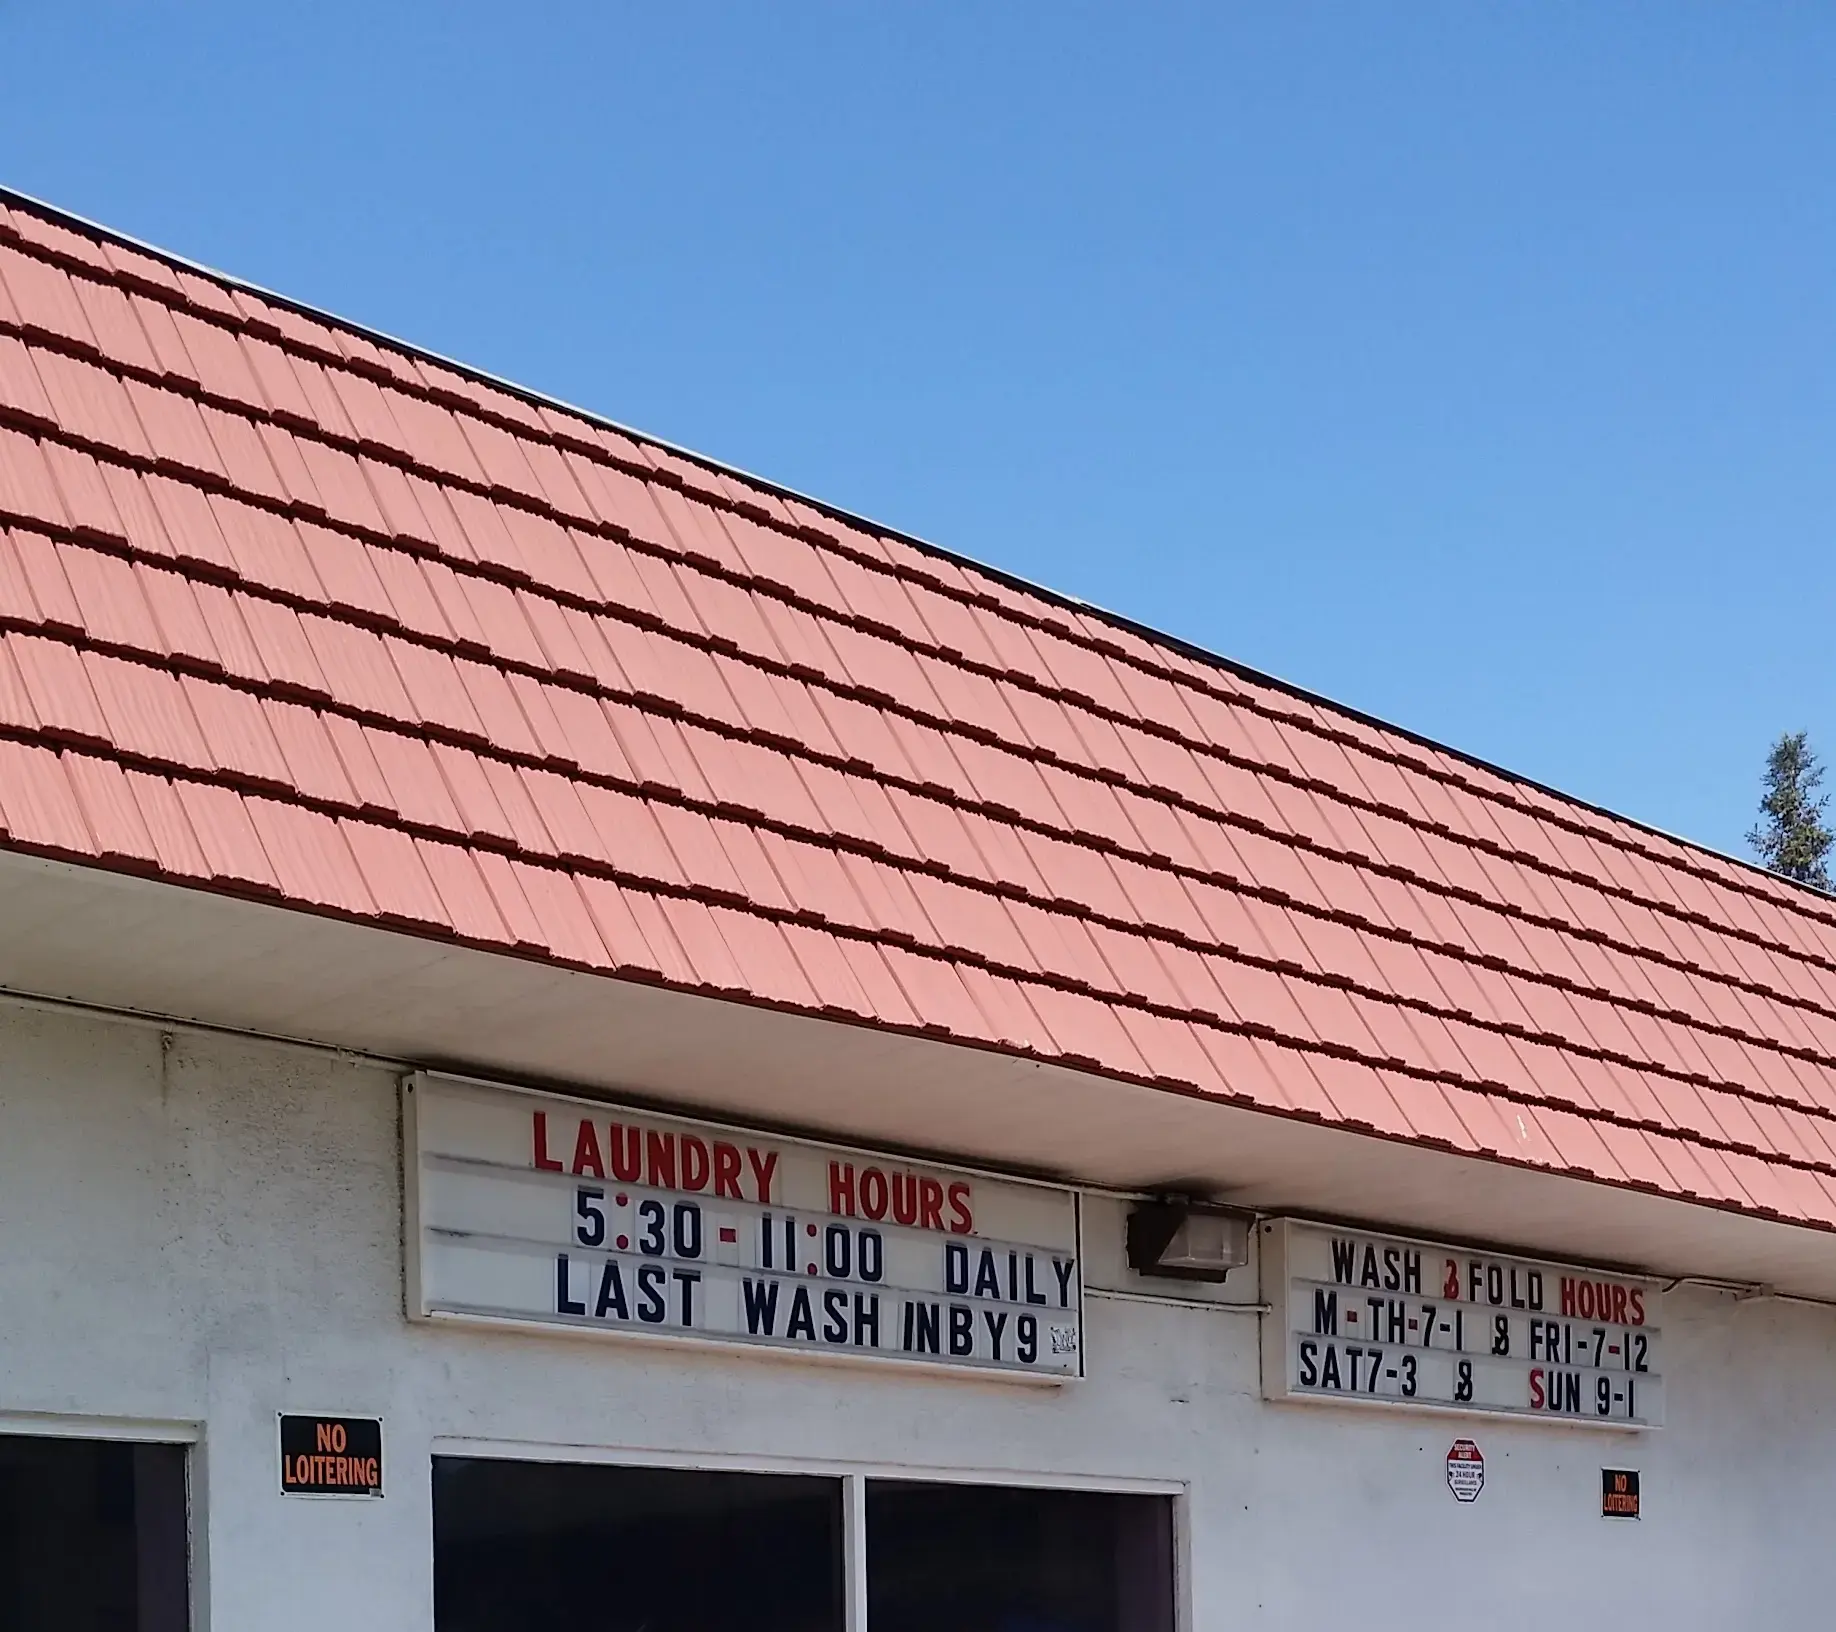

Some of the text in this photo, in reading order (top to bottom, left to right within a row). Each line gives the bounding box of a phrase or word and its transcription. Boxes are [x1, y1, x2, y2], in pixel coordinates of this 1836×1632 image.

[533, 1110, 974, 1235] LAUNDRY HOURS
[944, 1240, 1075, 1308] DAILY
[1331, 1237, 1422, 1294] WASH
[1468, 1259, 1544, 1312] FOLD
[1560, 1276, 1646, 1327] HOURS
[556, 1253, 703, 1327] LAST
[742, 1277, 880, 1348] WASH
[1529, 1367, 1581, 1413] SUN
[316, 1422, 347, 1453] NO
[284, 1454, 379, 1487] LOITERING
[1614, 1474, 1627, 1492] NO
[1603, 1492, 1638, 1513] LOITERING
